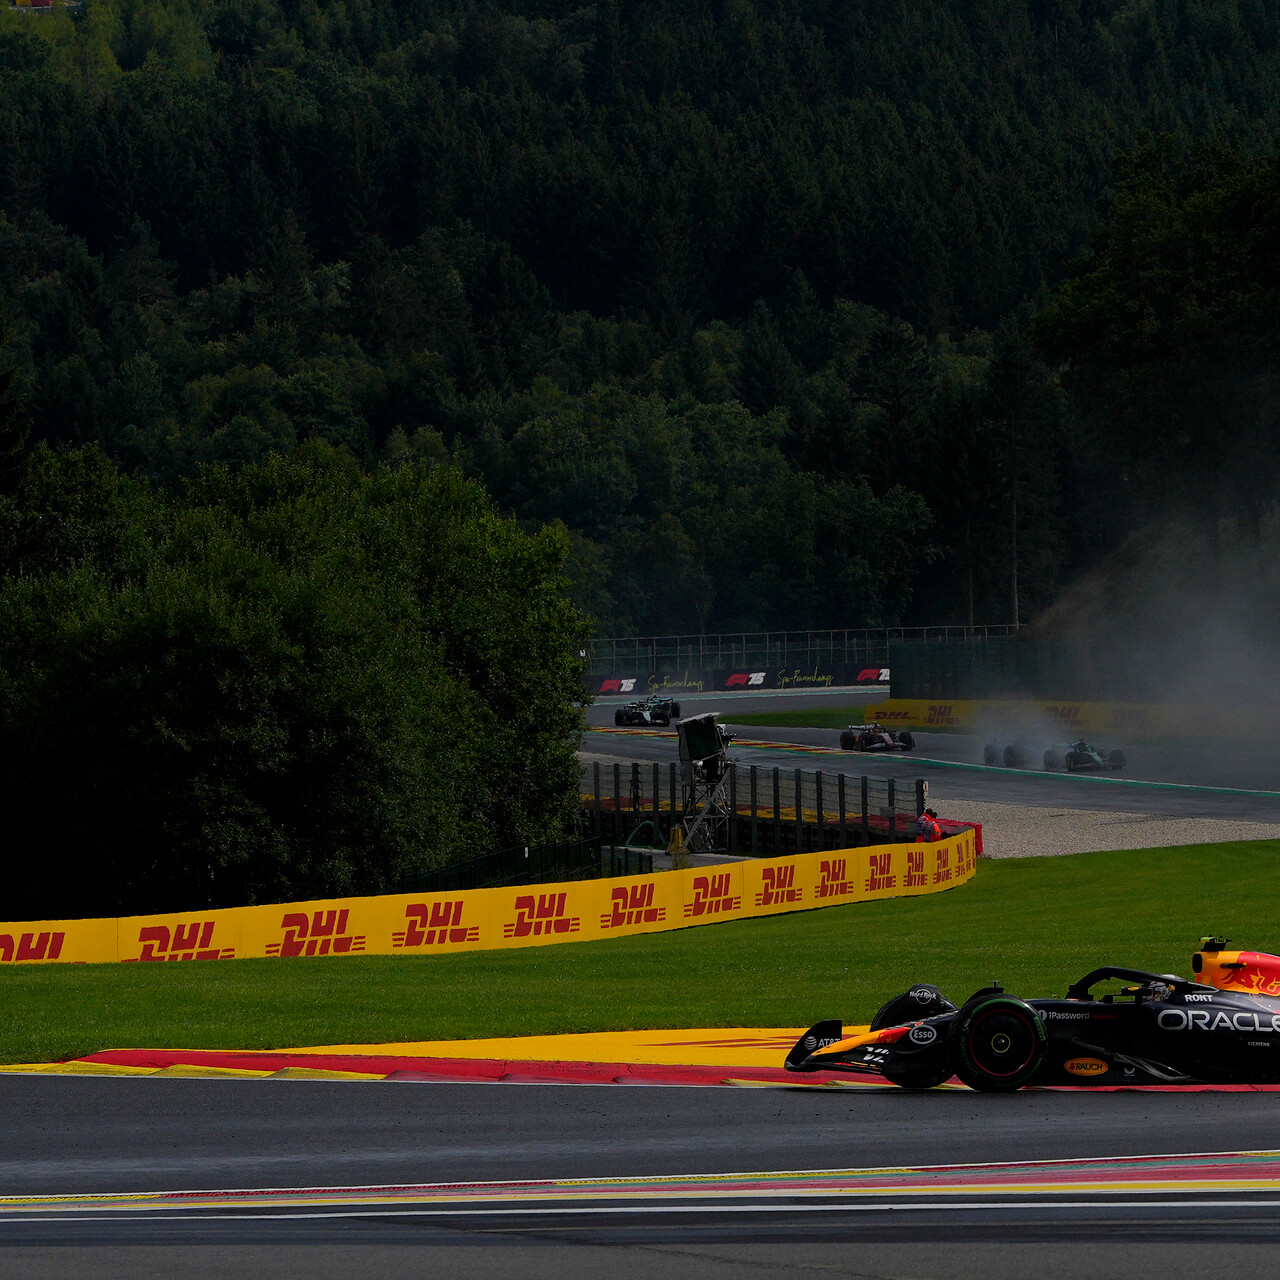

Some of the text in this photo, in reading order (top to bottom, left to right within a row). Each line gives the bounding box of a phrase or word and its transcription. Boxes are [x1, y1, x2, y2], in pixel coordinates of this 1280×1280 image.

[762, 865, 797, 907] DHL
[819, 859, 848, 898] DHL
[868, 853, 893, 892] DHL
[513, 892, 571, 938] DHL
[611, 883, 659, 928] DHL
[692, 873, 734, 917] DHL
[137, 921, 220, 962] DHL
[279, 909, 353, 958] DHL
[403, 901, 469, 947] DHL
[1048, 1011, 1090, 1020] 1Password
[1184, 993, 1213, 1003] ROKT
[1075, 1063, 1103, 1071] RAUCH
